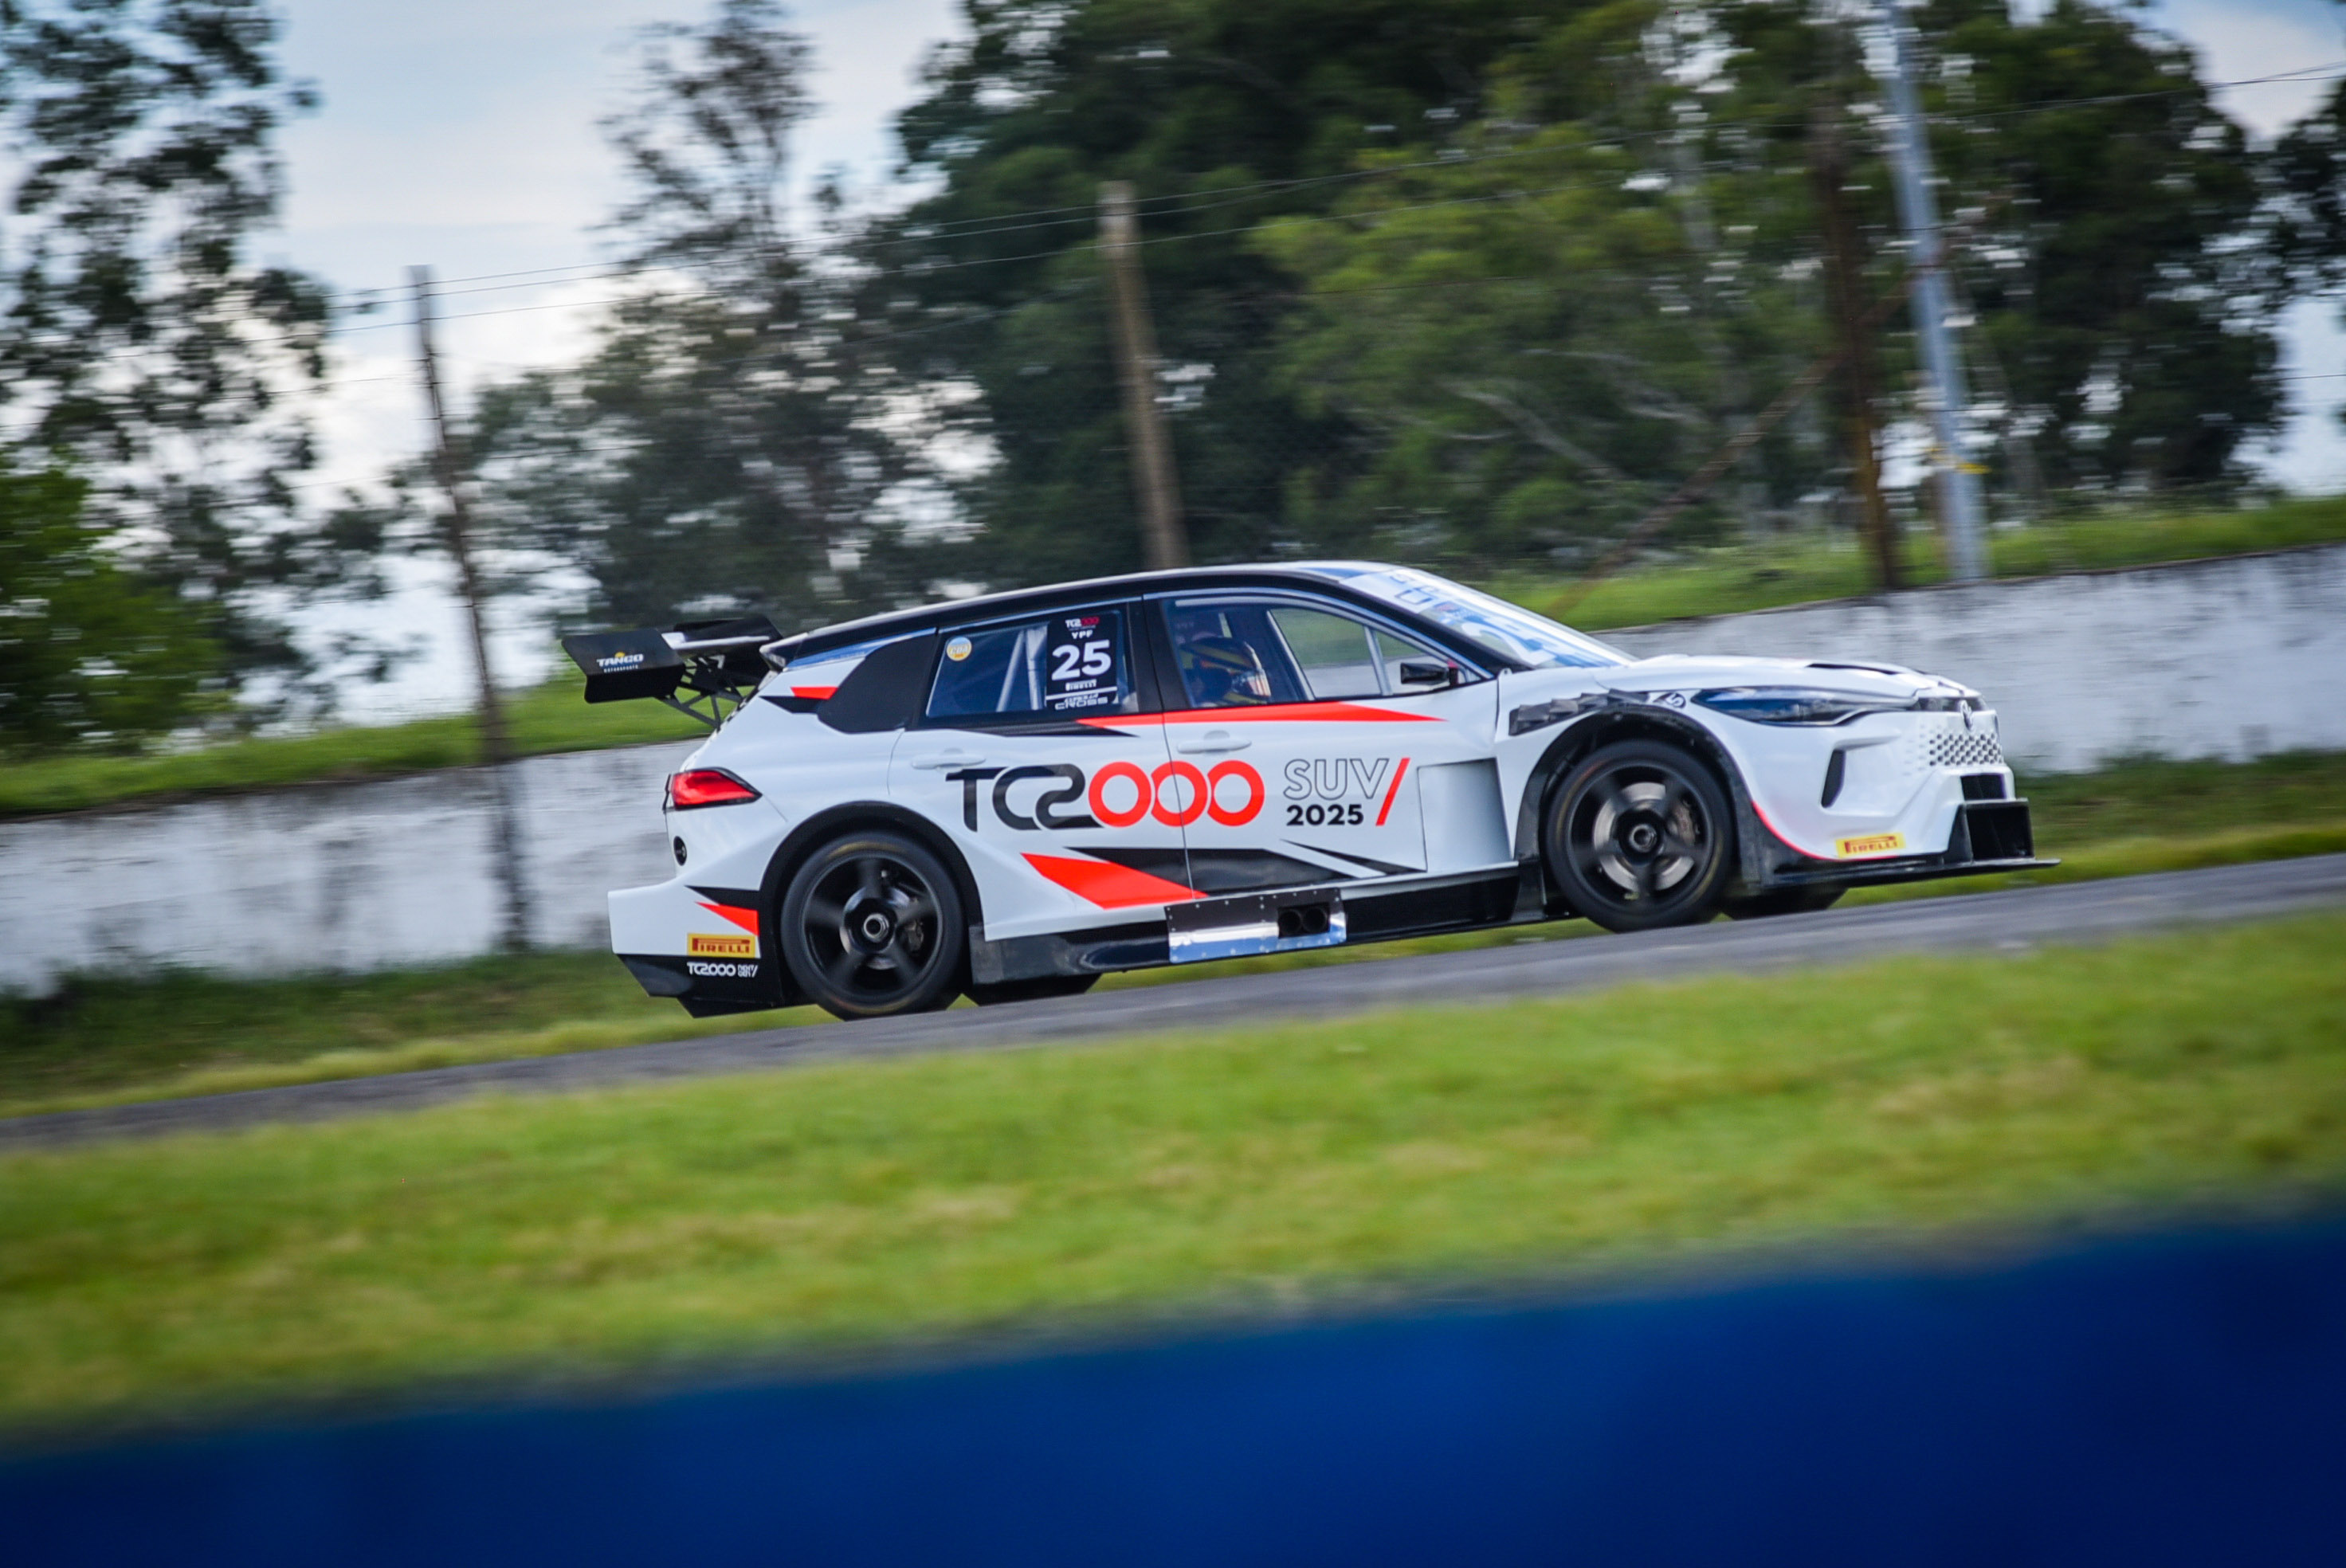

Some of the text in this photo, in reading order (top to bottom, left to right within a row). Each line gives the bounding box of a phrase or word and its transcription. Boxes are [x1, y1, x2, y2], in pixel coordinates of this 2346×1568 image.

[1071, 629, 1093, 639] YPF
[596, 653, 644, 667] TANGO
[1051, 639, 1112, 681] 25
[1054, 696, 1108, 710] CROSS
[945, 759, 1265, 833] TC2000
[1285, 803, 1364, 827] 2025
[1844, 836, 1897, 854] PIRELLI
[692, 937, 751, 954] PIRELLI
[687, 962, 736, 977] TC2000
